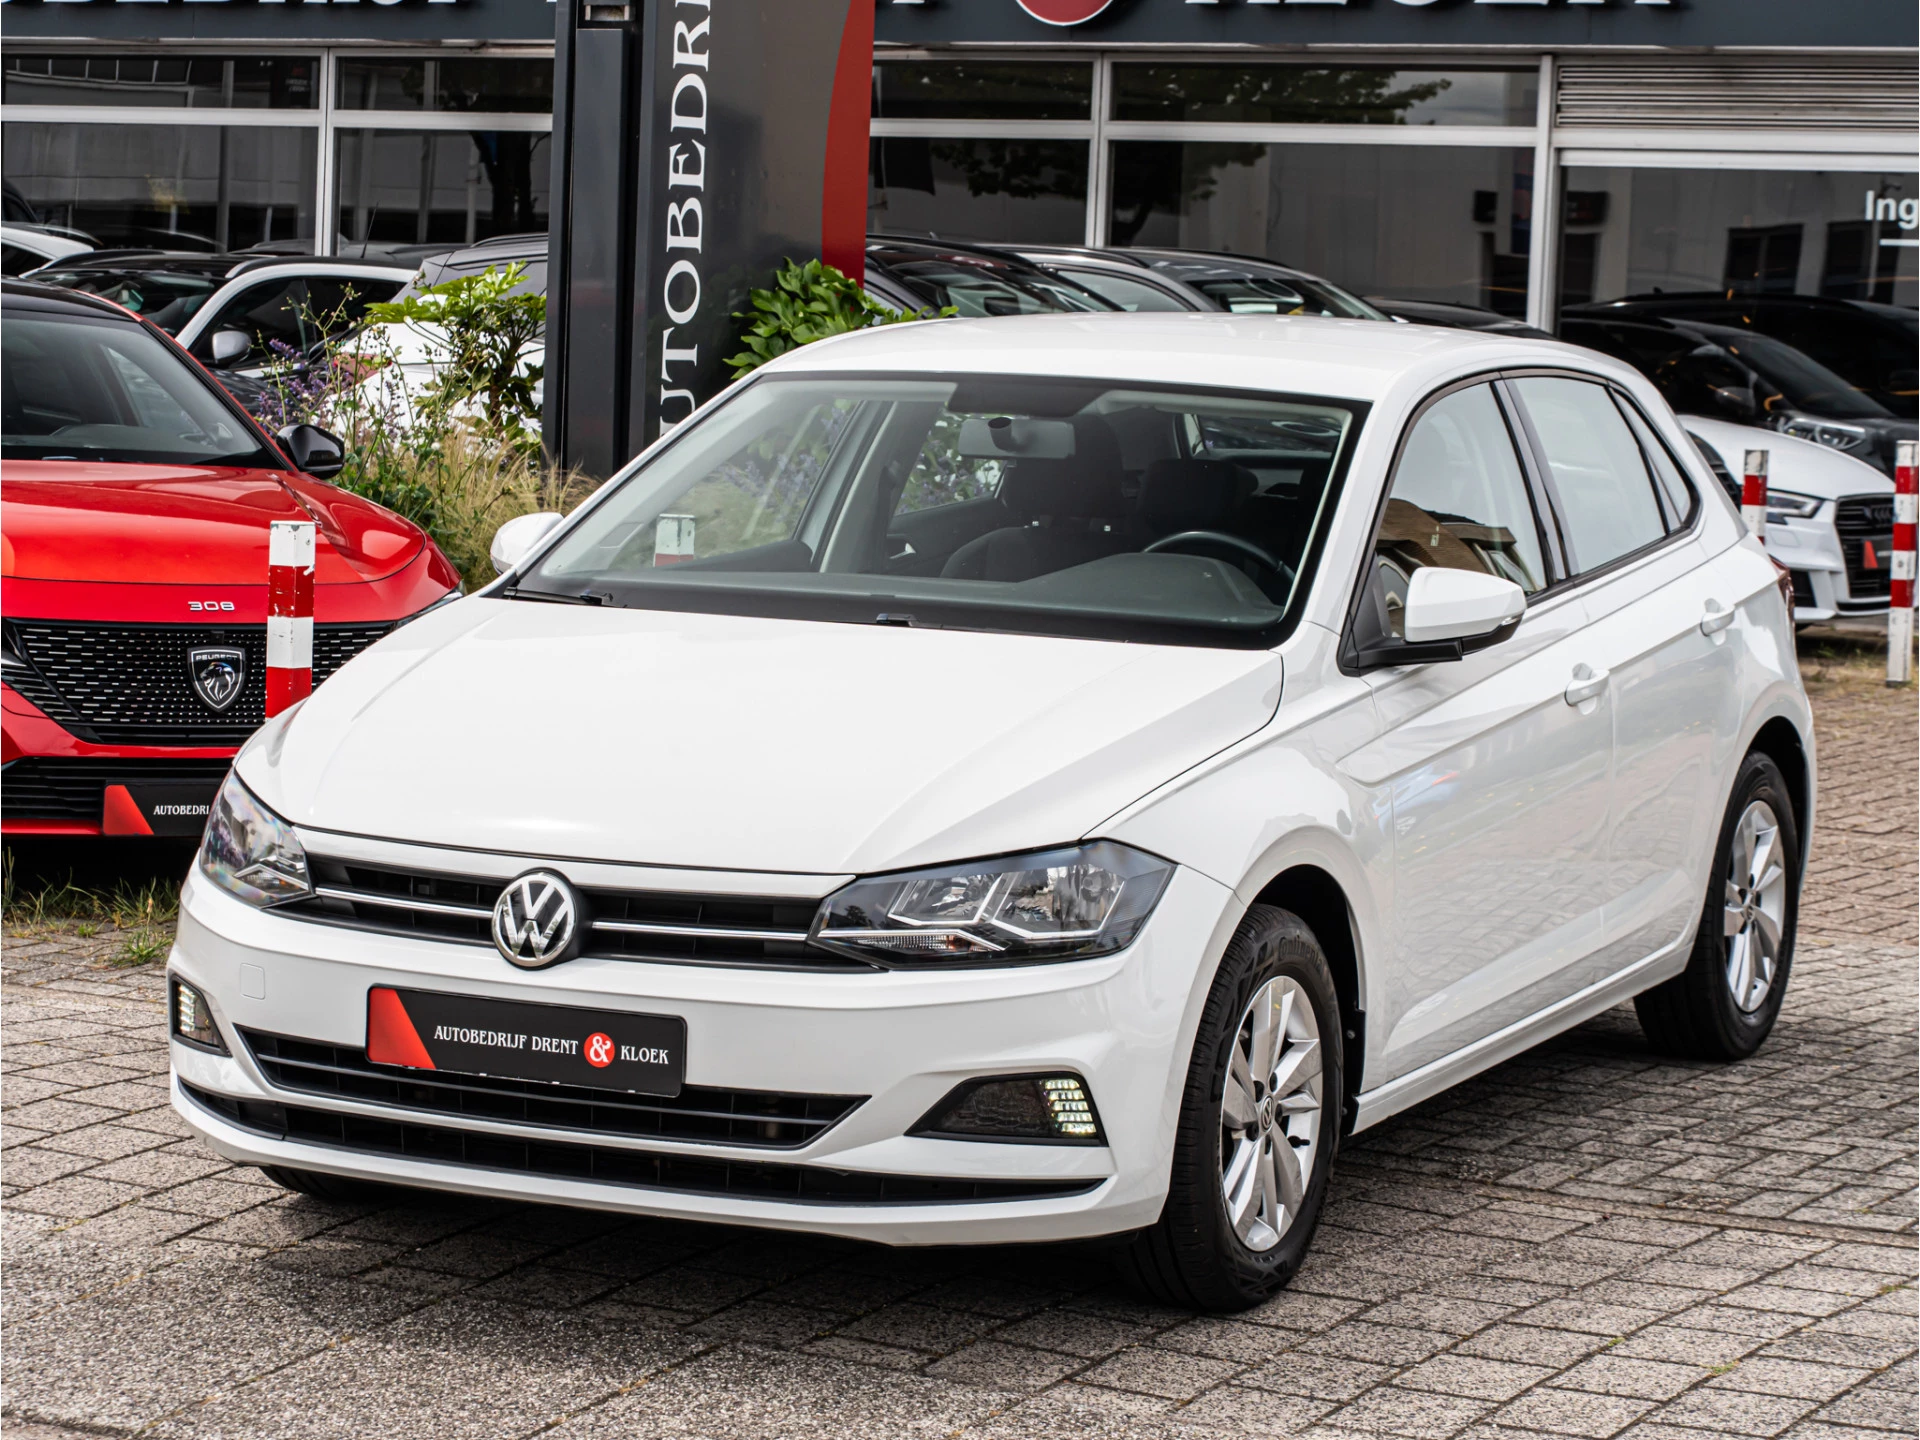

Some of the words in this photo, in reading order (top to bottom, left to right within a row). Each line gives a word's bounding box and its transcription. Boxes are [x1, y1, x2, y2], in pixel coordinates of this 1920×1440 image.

[1865, 190, 1919, 230] Ing
[188, 601, 235, 611] 308
[434, 1025, 527, 1049] AUTOBEDRIJF
[532, 1036, 579, 1055] DRENT
[589, 1036, 611, 1063] &
[620, 1045, 669, 1065] KLOEK
